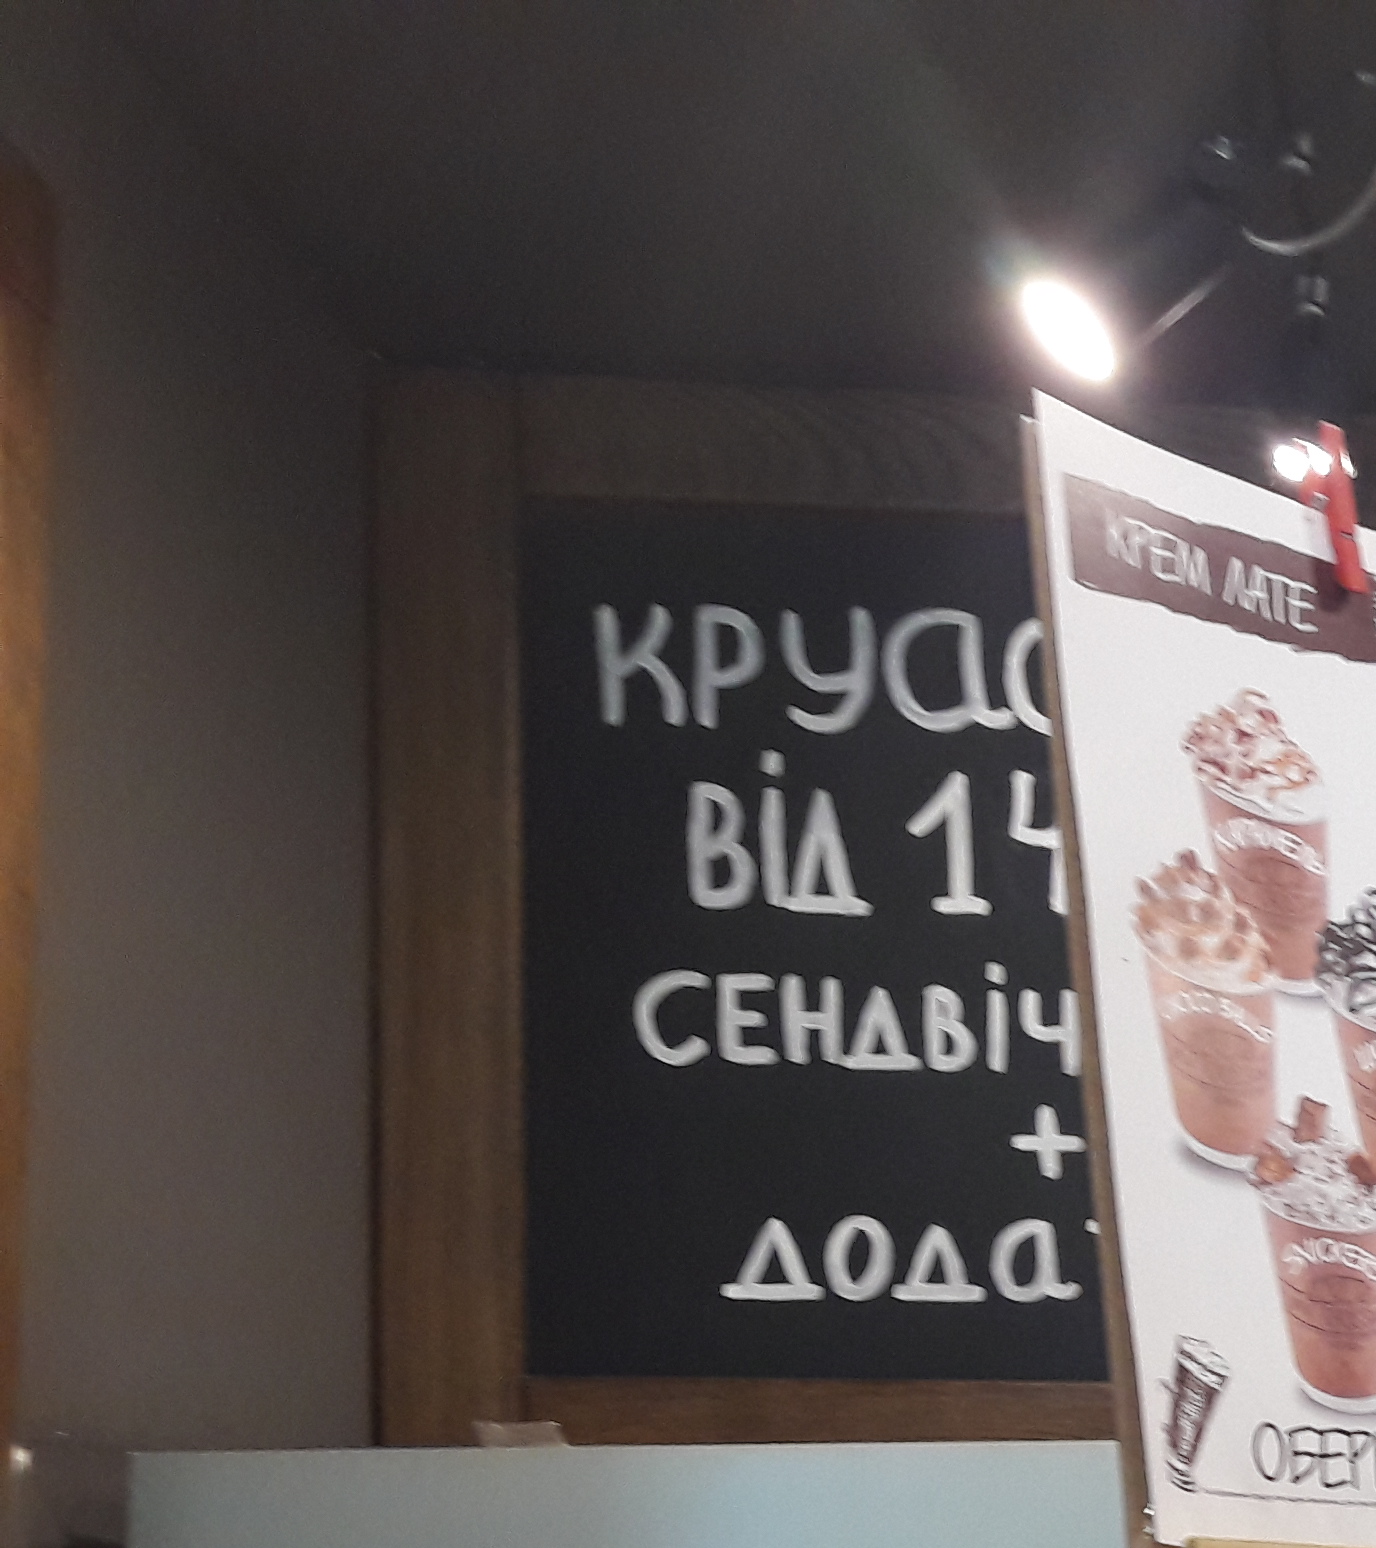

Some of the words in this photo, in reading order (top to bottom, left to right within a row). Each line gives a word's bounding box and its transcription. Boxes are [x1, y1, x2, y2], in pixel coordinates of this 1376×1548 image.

[1102, 510, 1213, 596] КРЕМ
[1221, 556, 1319, 634] ЛАТЕ
[719, 1216, 1101, 1303] ДОДА
